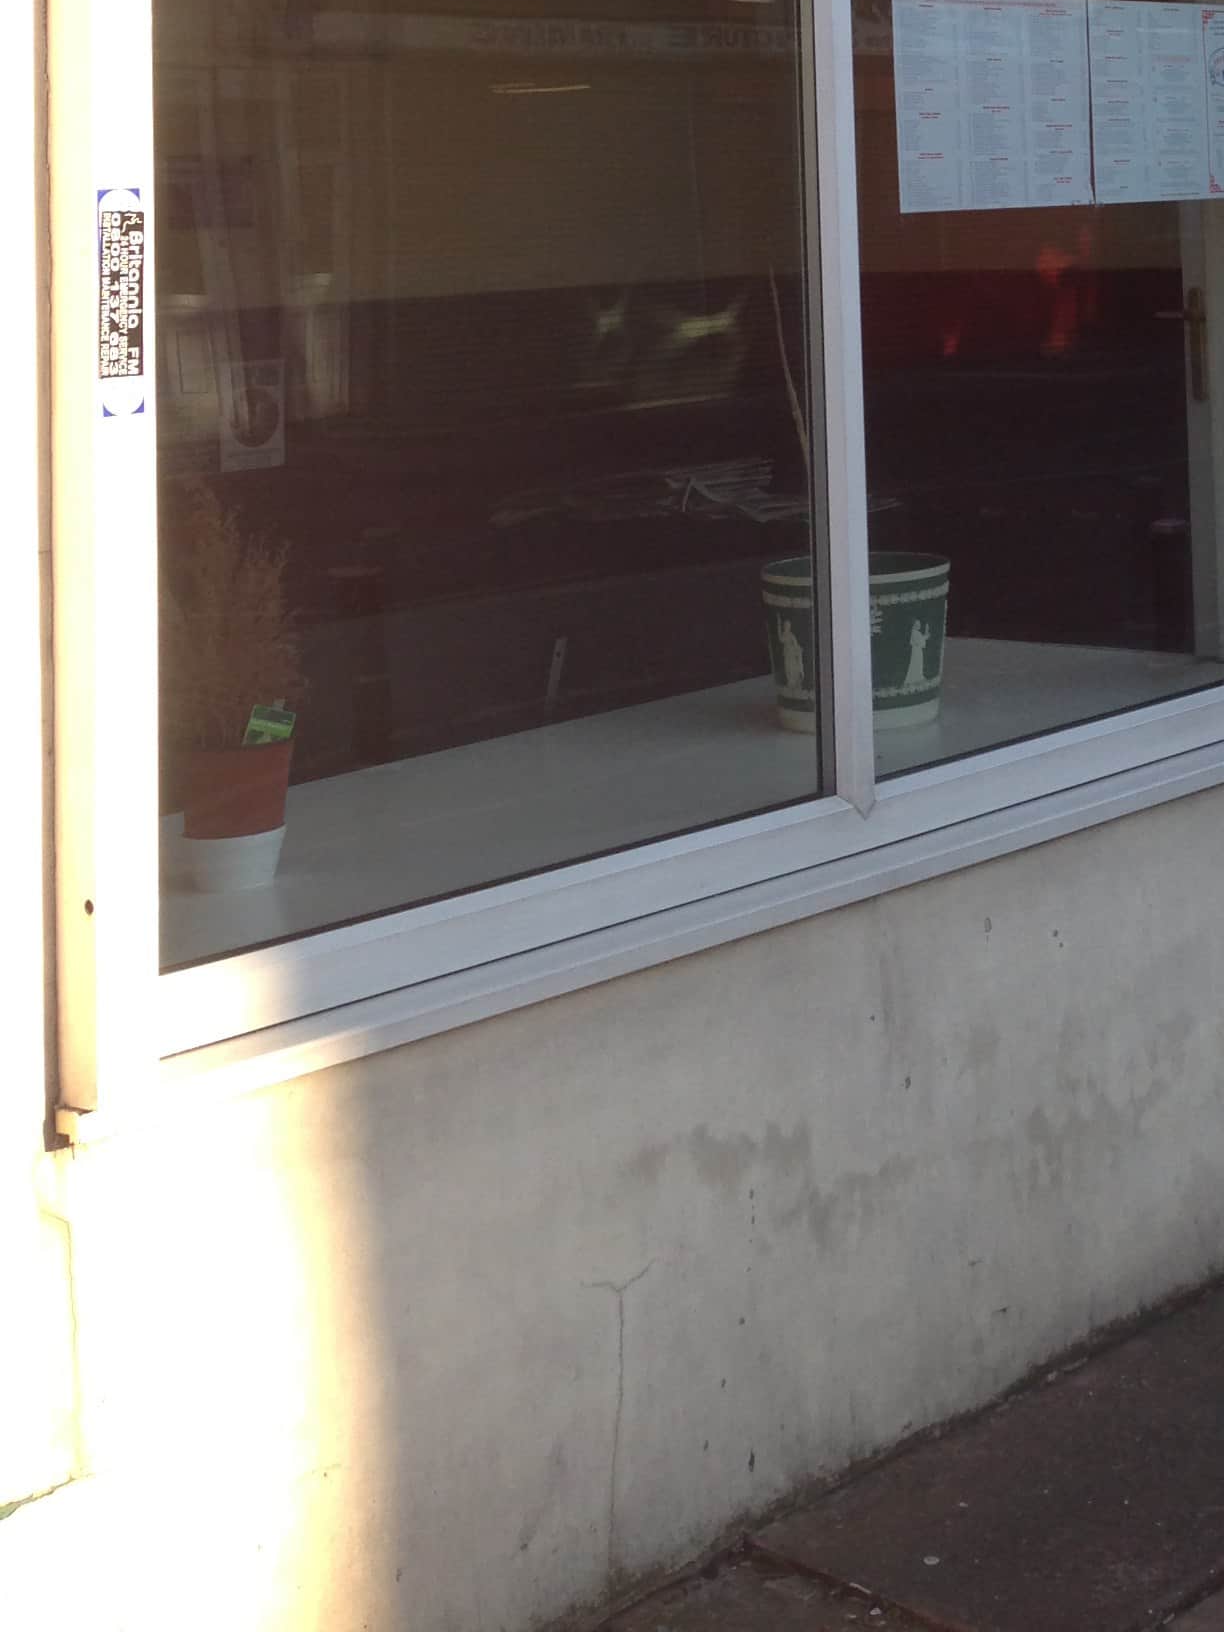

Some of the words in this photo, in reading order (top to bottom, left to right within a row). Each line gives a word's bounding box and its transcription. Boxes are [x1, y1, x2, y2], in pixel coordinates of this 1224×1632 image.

[110, 212, 121, 271] 0800
[110, 279, 121, 324] 137
[118, 335, 128, 376] SERVICE
[127, 347, 140, 376] FM
